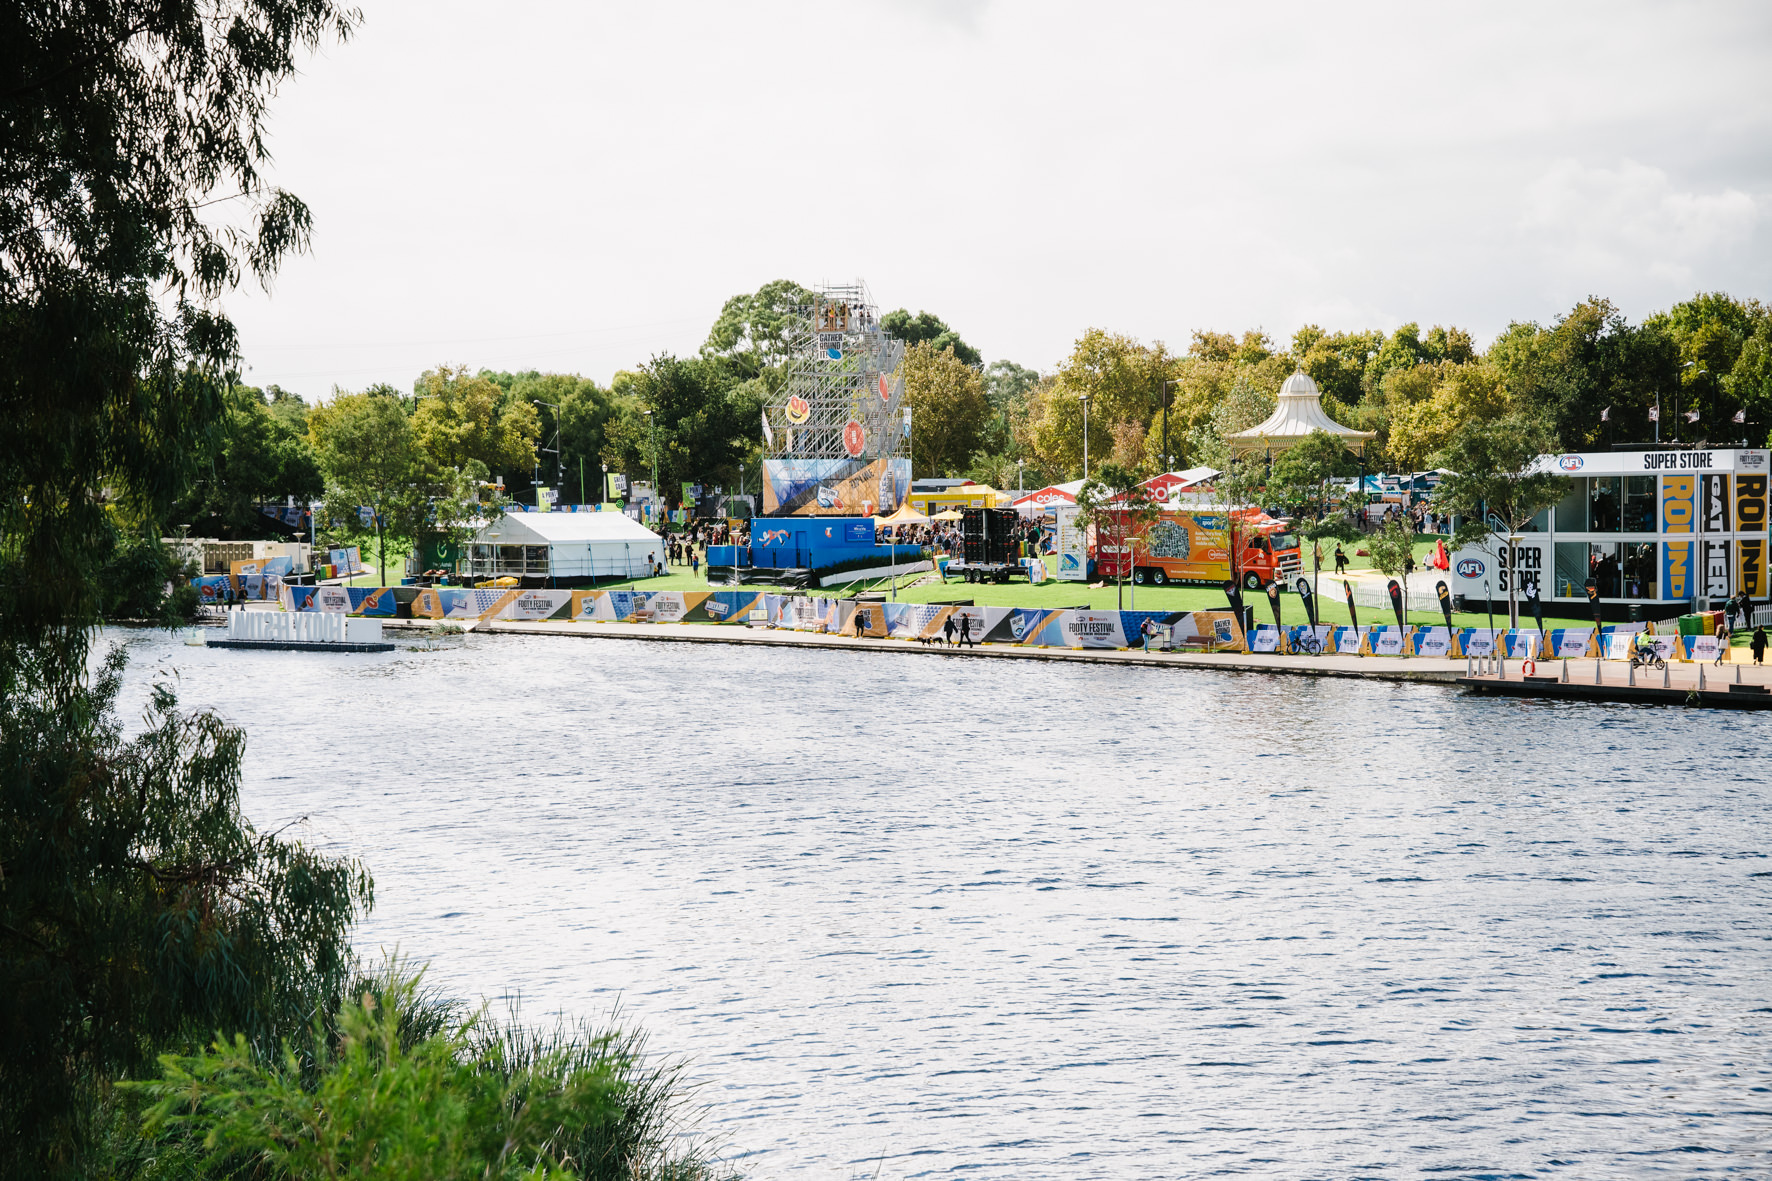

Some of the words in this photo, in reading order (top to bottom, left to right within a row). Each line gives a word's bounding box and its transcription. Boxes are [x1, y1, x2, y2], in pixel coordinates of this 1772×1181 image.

[1562, 457, 1582, 468] AFL
[1644, 453, 1677, 469] SUPER
[1680, 452, 1713, 468] STORE
[1036, 493, 1064, 502] coles
[1663, 476, 1694, 598] ROUND
[1708, 476, 1728, 597] GATHER
[1736, 476, 1767, 595] ROUND
[1499, 547, 1541, 568] SUPER
[1460, 563, 1482, 574] AFL
[1069, 623, 1087, 632] FOOTY
[1089, 623, 1115, 632] FESTIVAL
[1215, 620, 1230, 628] GATHER
